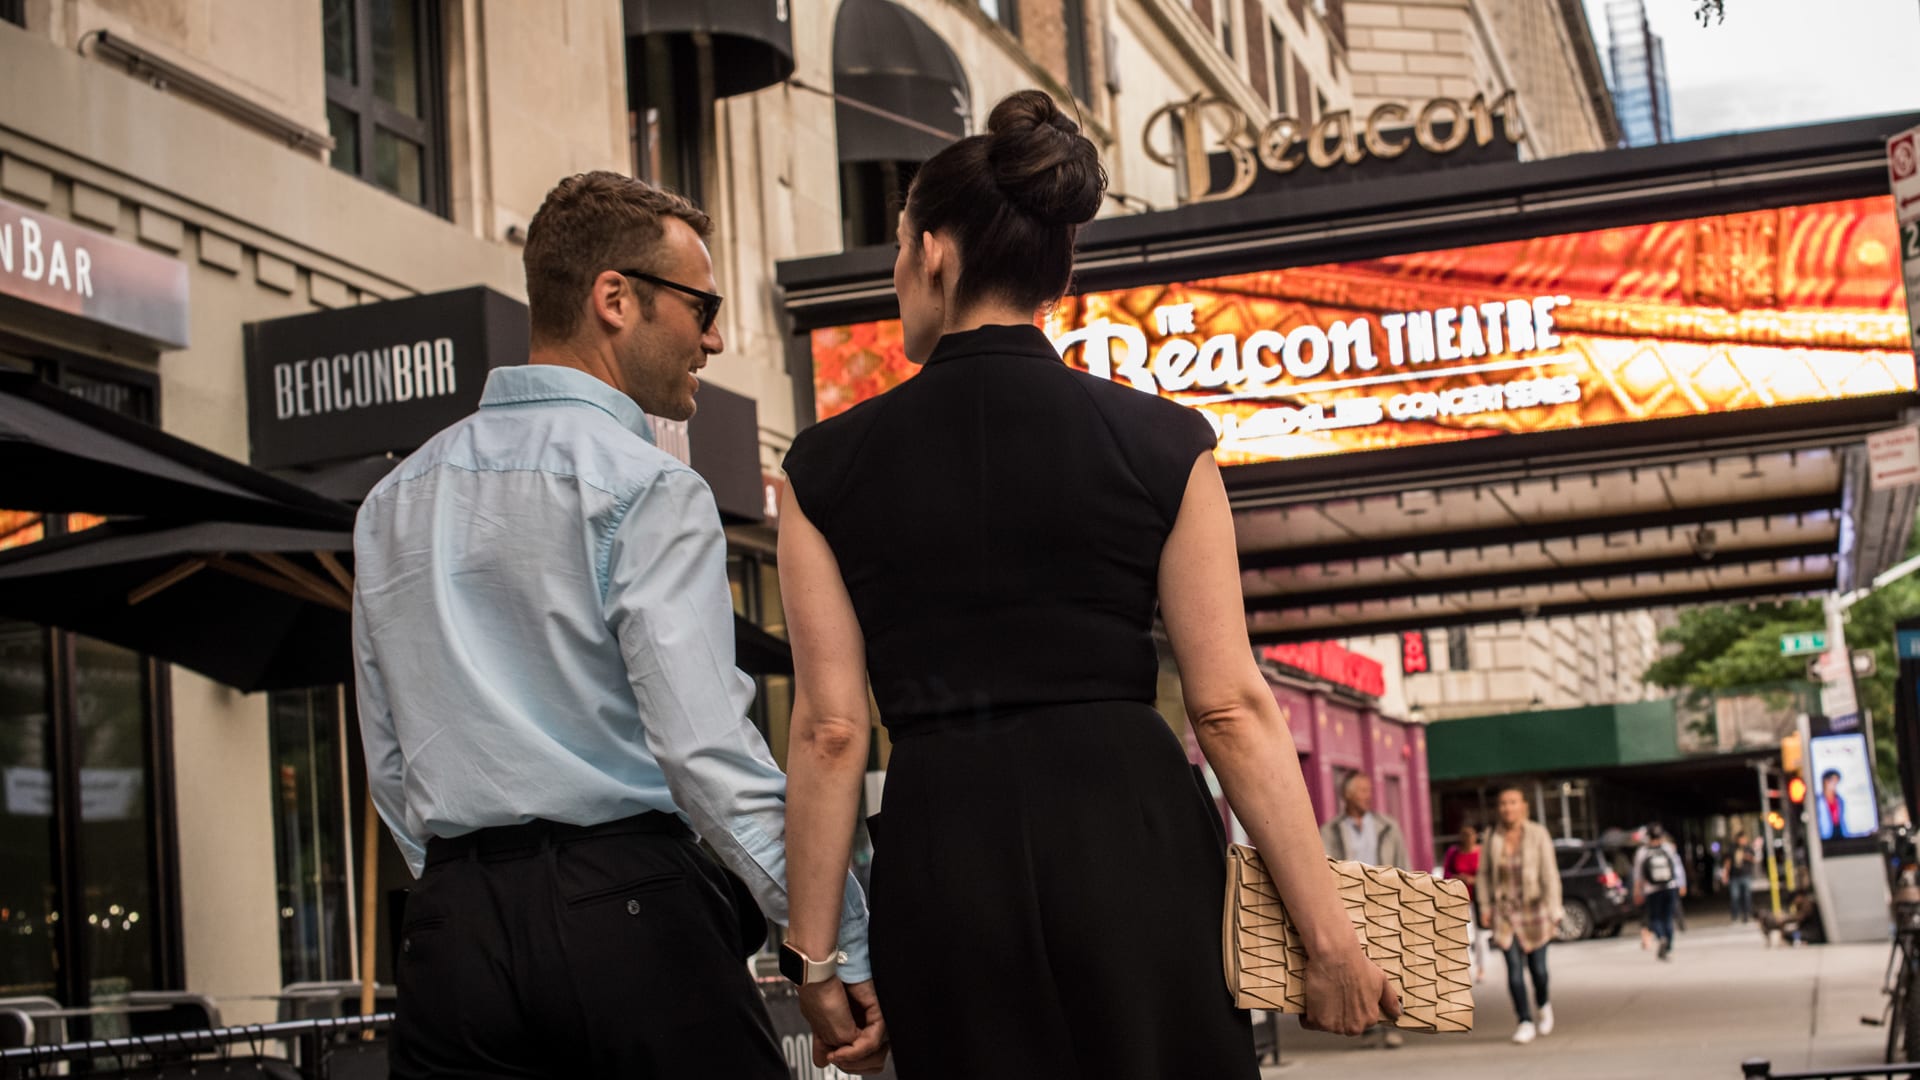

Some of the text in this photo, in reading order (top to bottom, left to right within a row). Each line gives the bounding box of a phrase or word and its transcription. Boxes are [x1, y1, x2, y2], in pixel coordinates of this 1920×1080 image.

[1142, 89, 1525, 204] Beacon
[1055, 296, 1561, 395] Beacon THEATRE
[1154, 302, 1196, 336] THE
